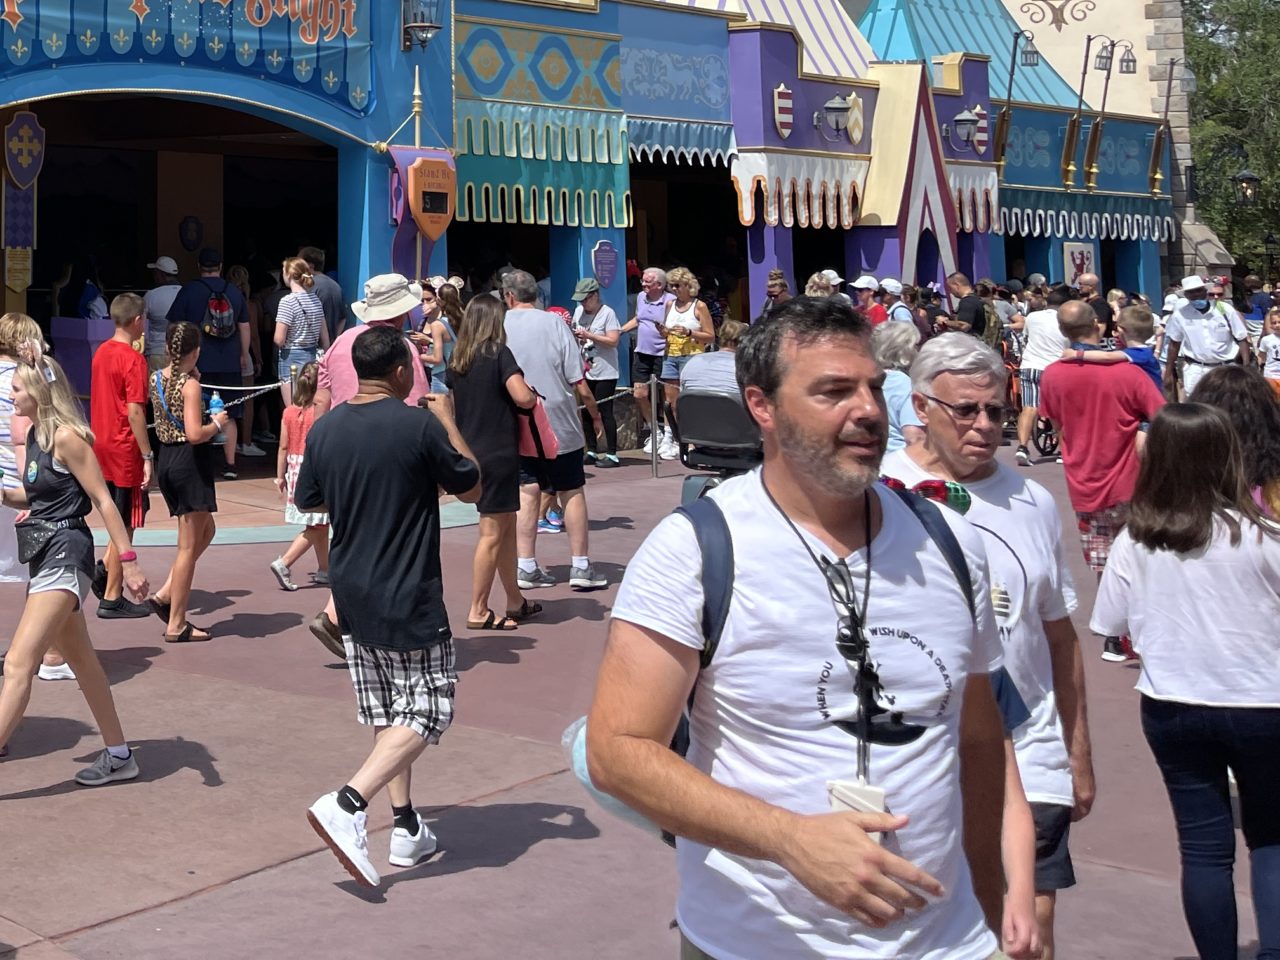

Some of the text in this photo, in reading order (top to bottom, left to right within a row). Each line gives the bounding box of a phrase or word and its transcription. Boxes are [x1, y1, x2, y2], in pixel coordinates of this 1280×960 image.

[869, 627, 895, 637] WISH
[896, 629, 926, 651] UPON
[926, 650, 934, 659] A
[818, 660, 834, 684] YOU
[816, 686, 832, 721] WHEN
